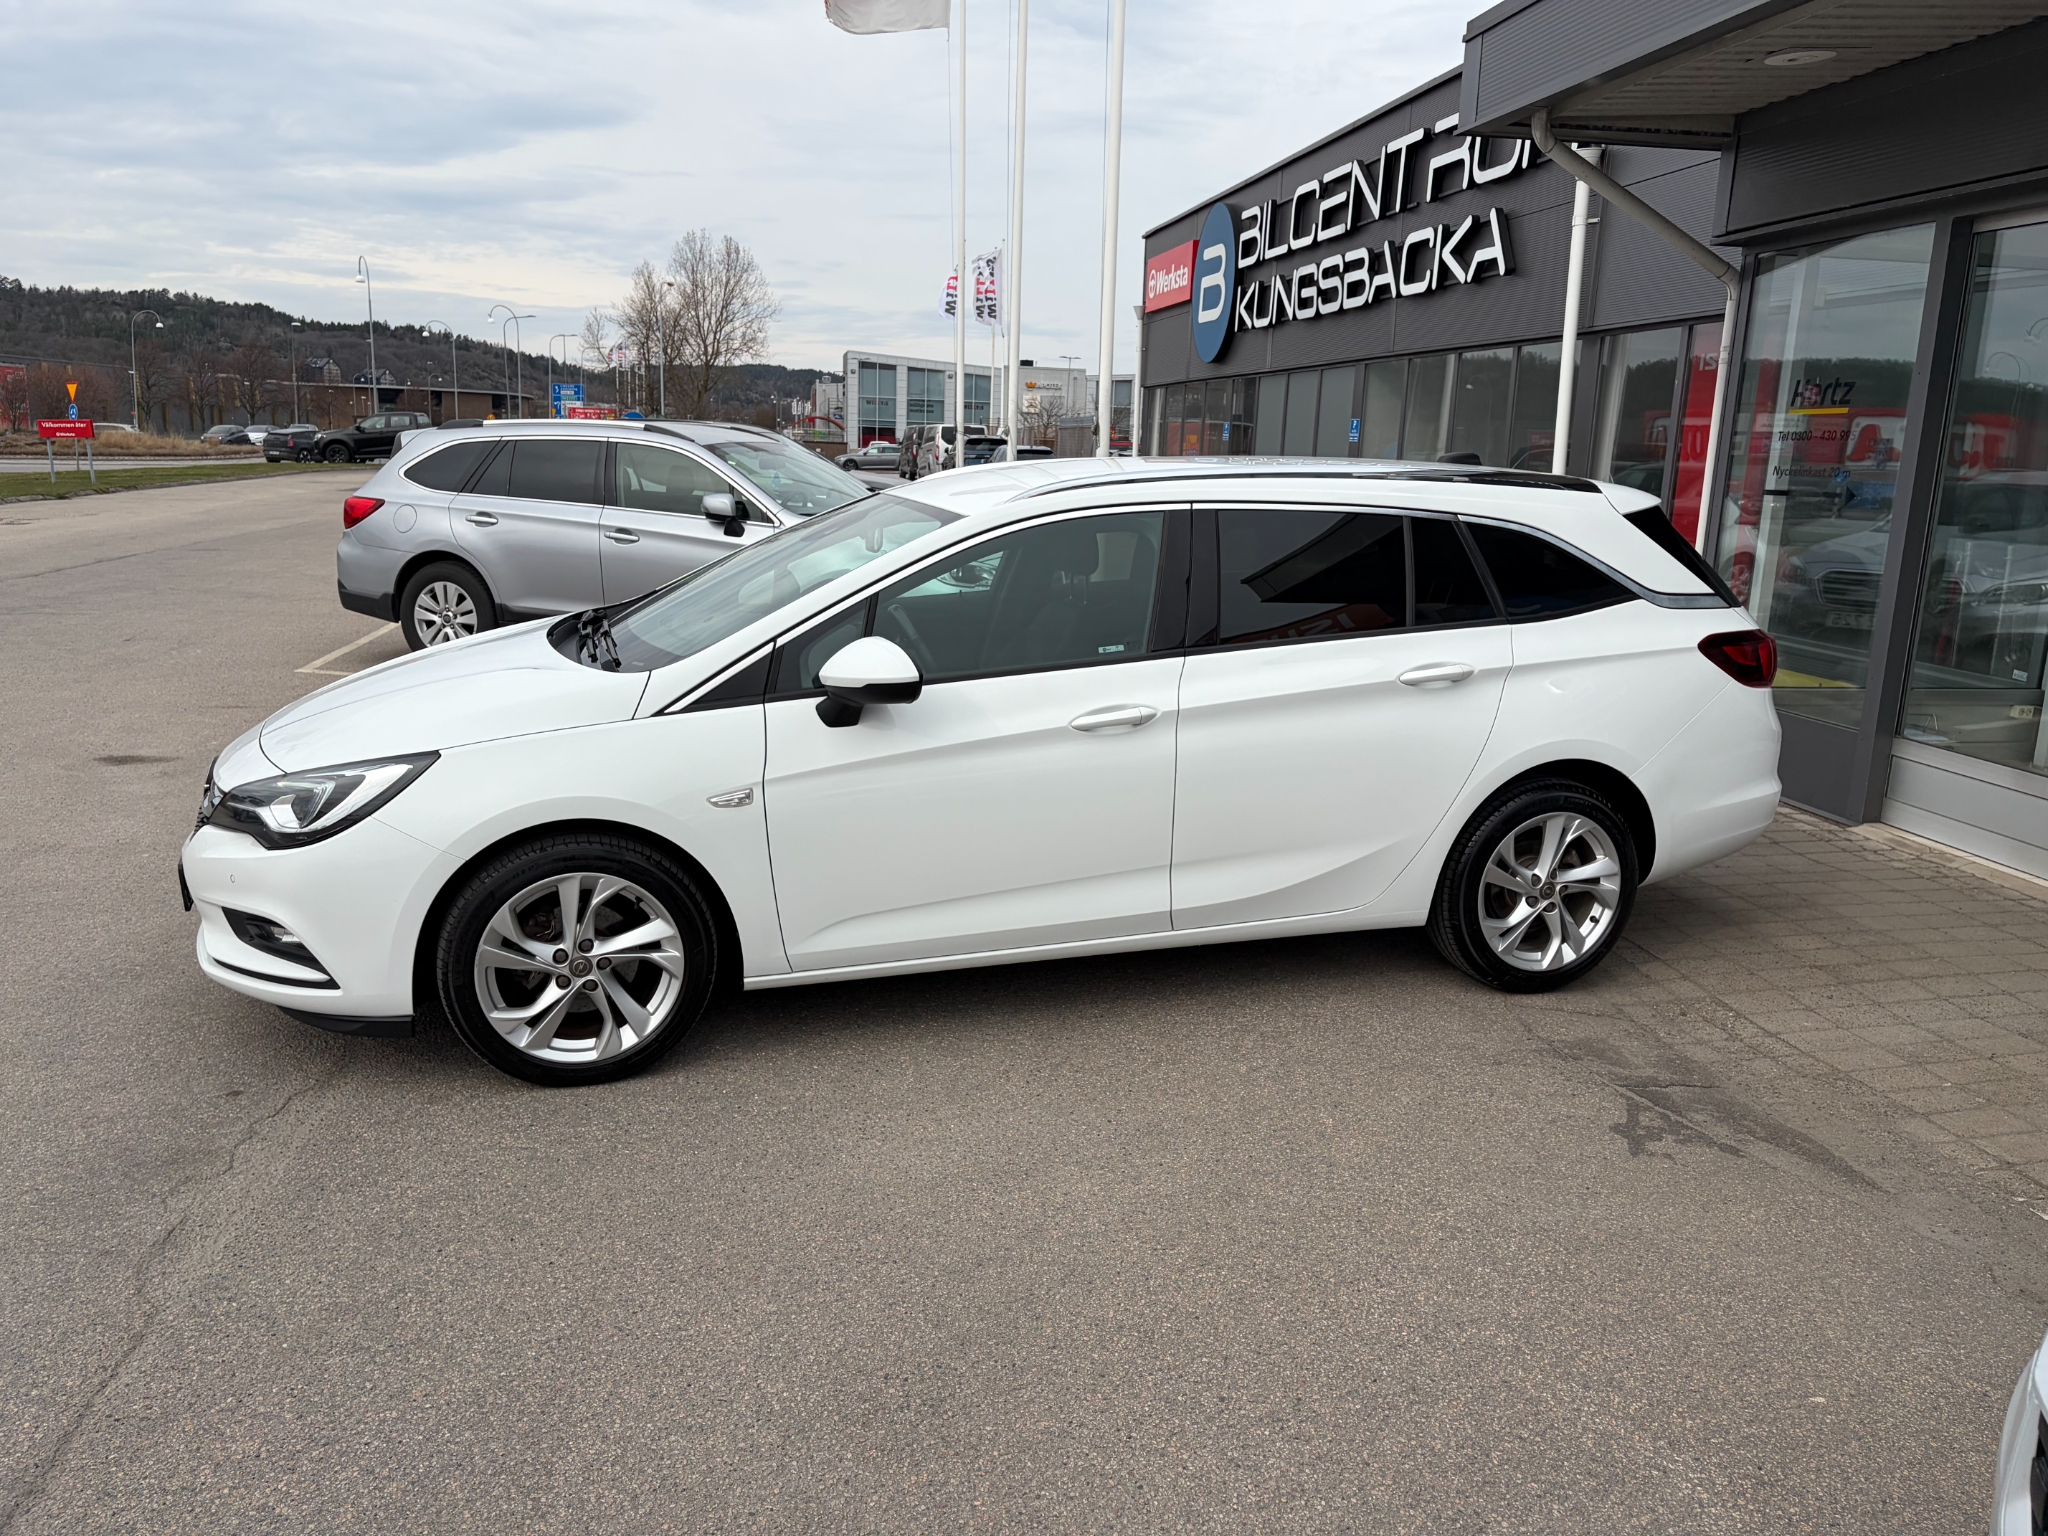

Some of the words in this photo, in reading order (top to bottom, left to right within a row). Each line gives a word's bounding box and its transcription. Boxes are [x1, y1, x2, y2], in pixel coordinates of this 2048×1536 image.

[1155, 263, 1188, 296] Werksta
[1235, 207, 1506, 332] KUNGSBACKA
[1791, 378, 1857, 407] Hertz
[1778, 431, 1789, 441] Tel
[1791, 430, 1813, 442] 0300
[1820, 430, 1837, 441] 430
[1839, 430, 1858, 441] 995
[1772, 465, 1826, 479] Nyckelinkast
[1829, 466, 1840, 478] 20
